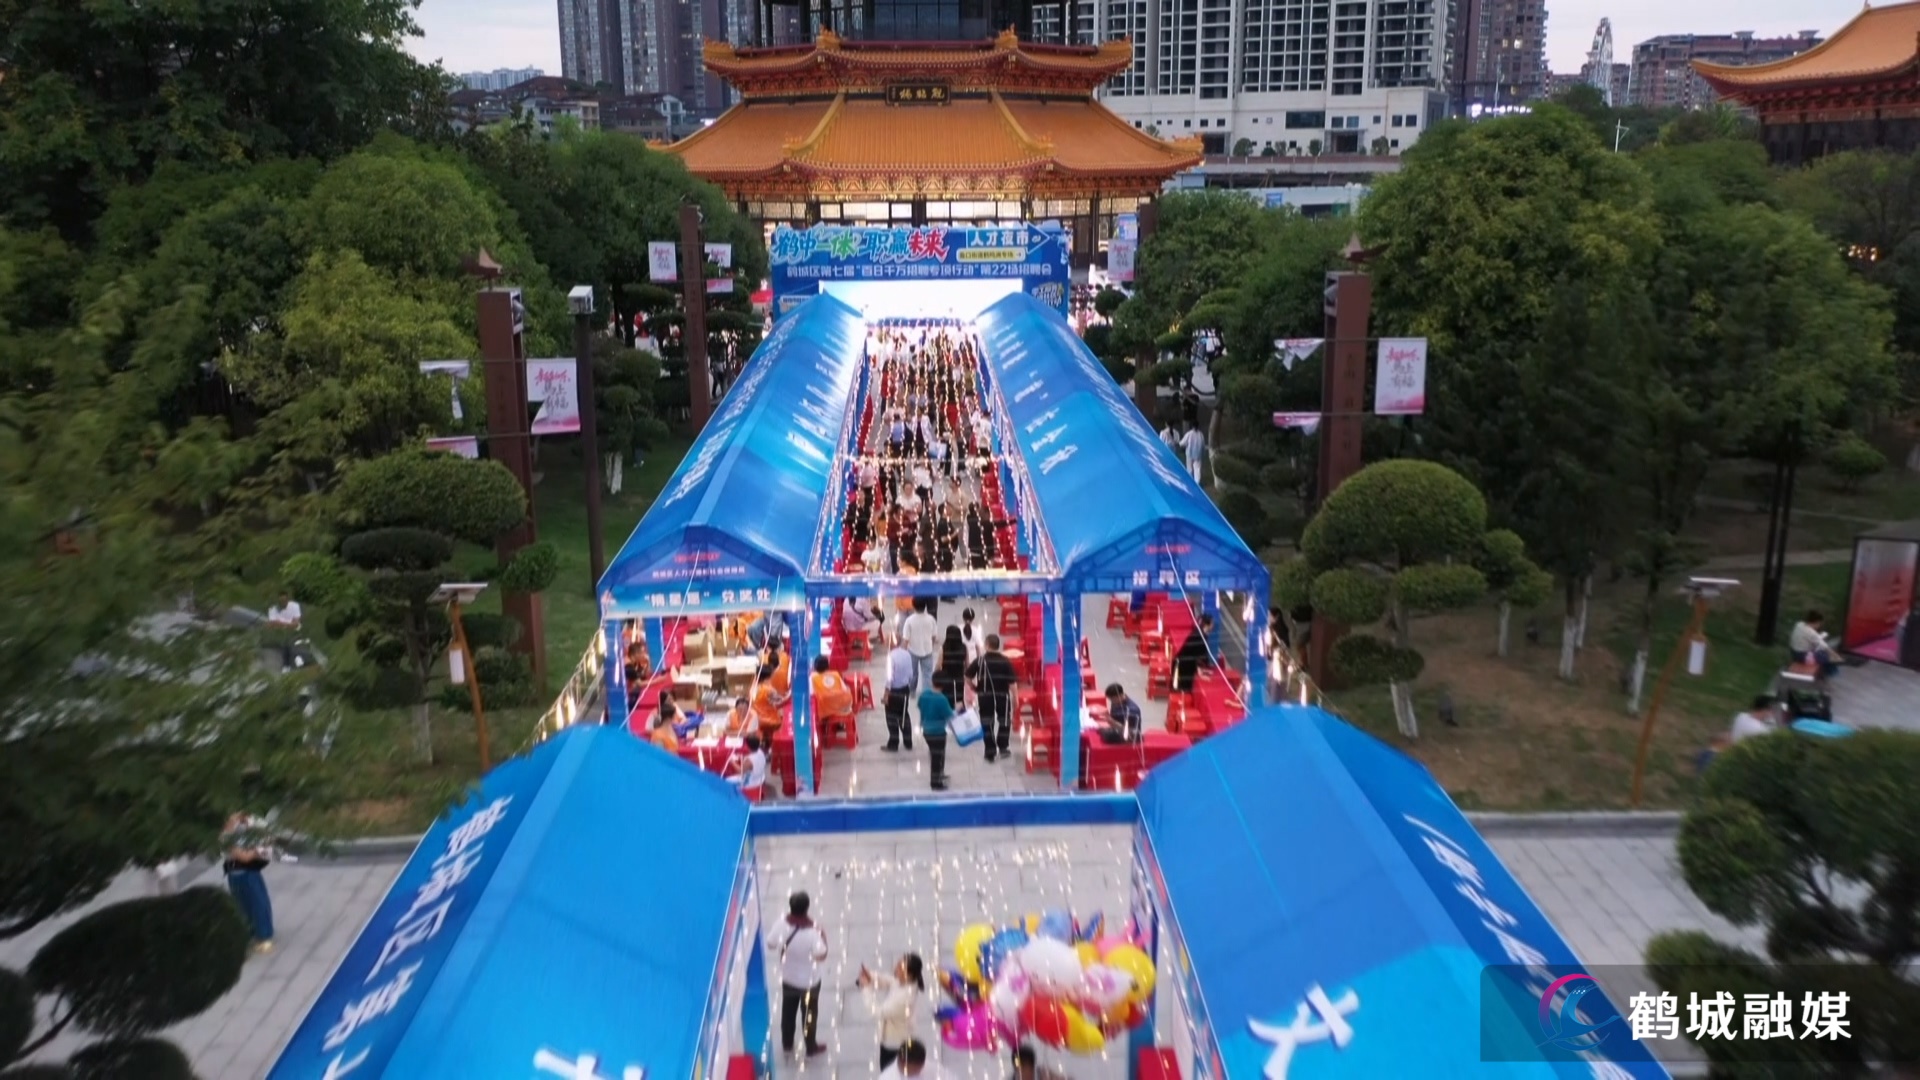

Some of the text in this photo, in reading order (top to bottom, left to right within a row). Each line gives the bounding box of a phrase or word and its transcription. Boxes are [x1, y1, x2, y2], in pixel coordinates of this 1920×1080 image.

[970, 231, 1028, 247] 人才夜市
[721, 587, 771, 604] 兑奖处
